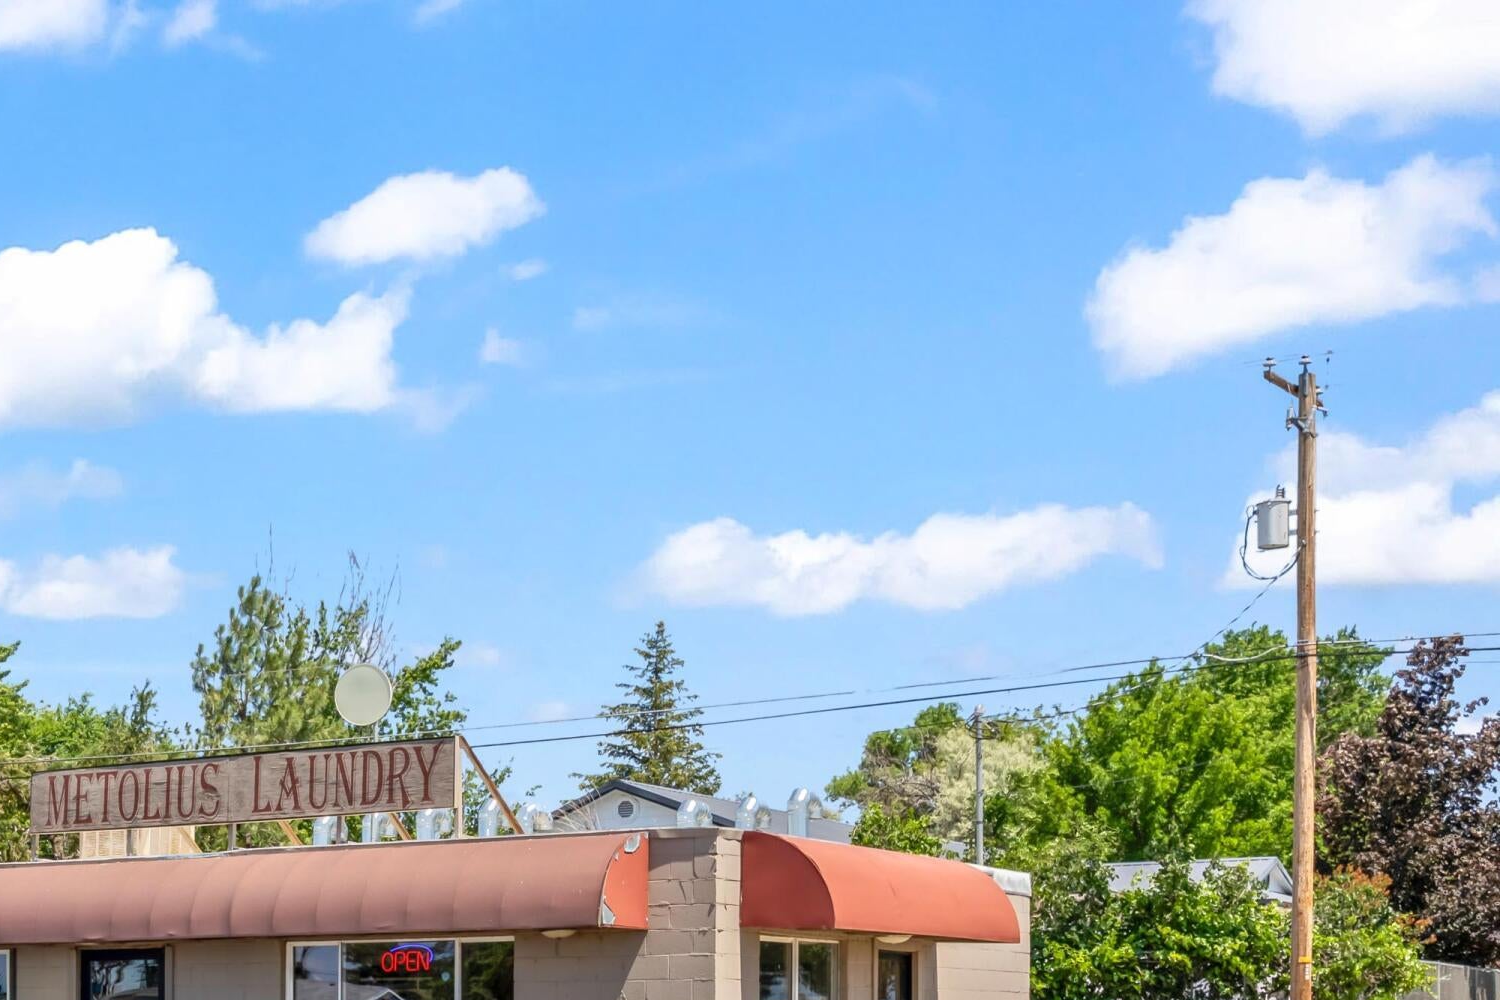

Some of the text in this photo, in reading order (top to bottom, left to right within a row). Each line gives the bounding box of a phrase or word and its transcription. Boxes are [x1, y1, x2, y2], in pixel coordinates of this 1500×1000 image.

[45, 739, 445, 827] METOLIUS LAUNDRY
[381, 950, 430, 973] OPEN
